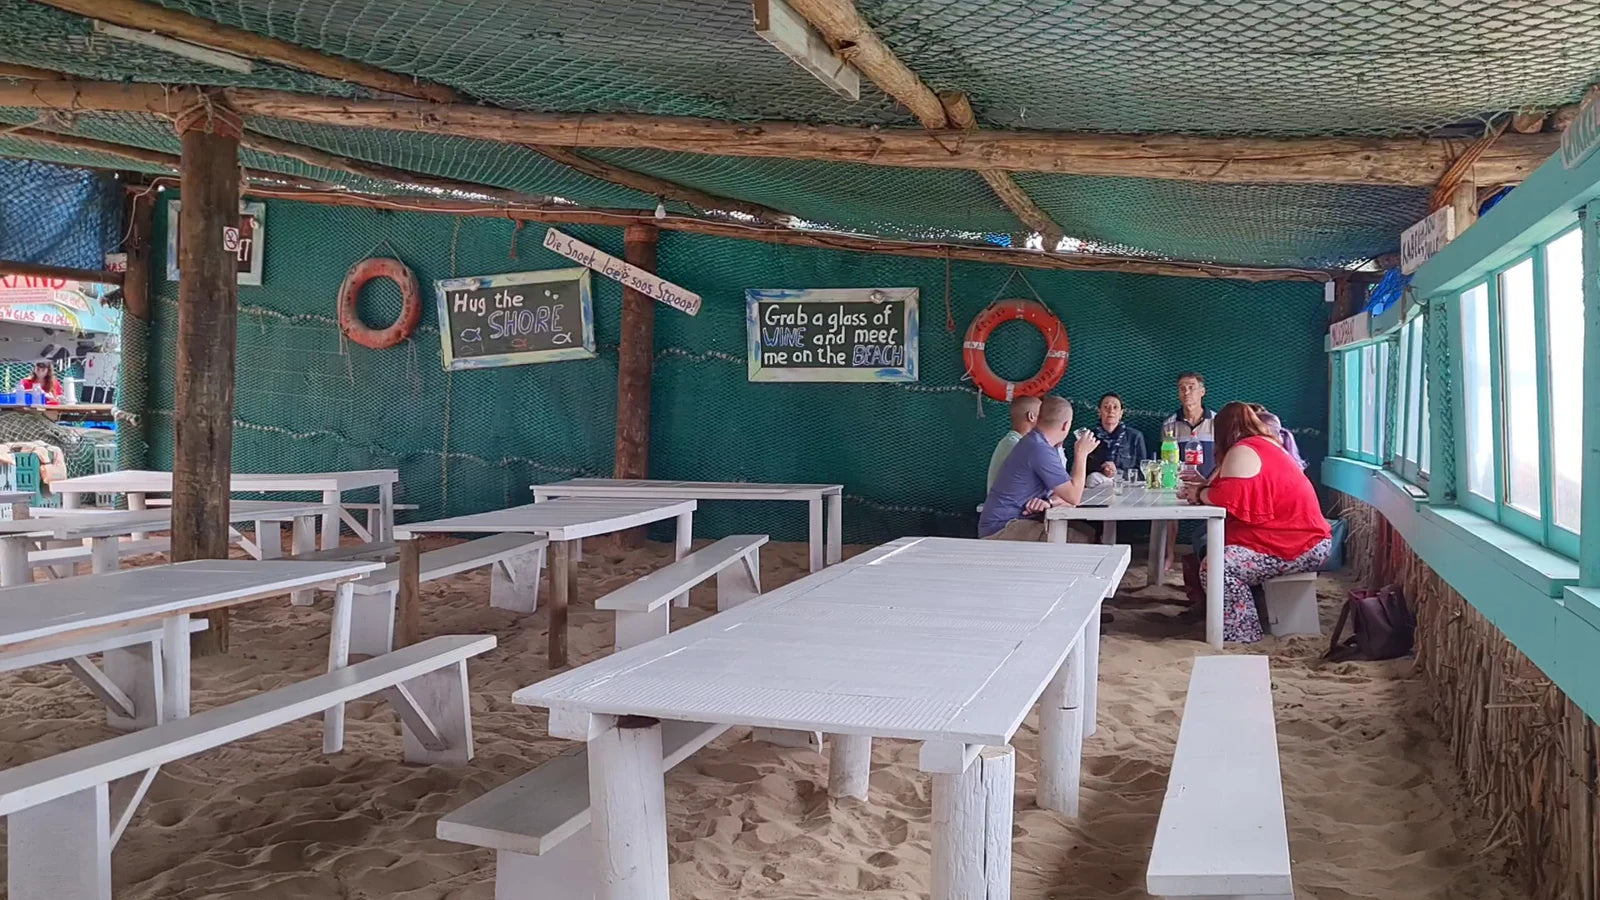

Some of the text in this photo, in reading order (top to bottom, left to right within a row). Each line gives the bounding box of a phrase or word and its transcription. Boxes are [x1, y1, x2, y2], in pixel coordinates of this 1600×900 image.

[546, 231, 562, 251] Die
[564, 239, 597, 268] Snoek
[631, 276, 654, 295] soos
[453, 289, 524, 317] Hug the
[487, 304, 565, 340] SHORE
[764, 304, 893, 333] Grab a glass of
[762, 326, 898, 347] WINE and meet
[763, 344, 904, 367] me on the BEACH
